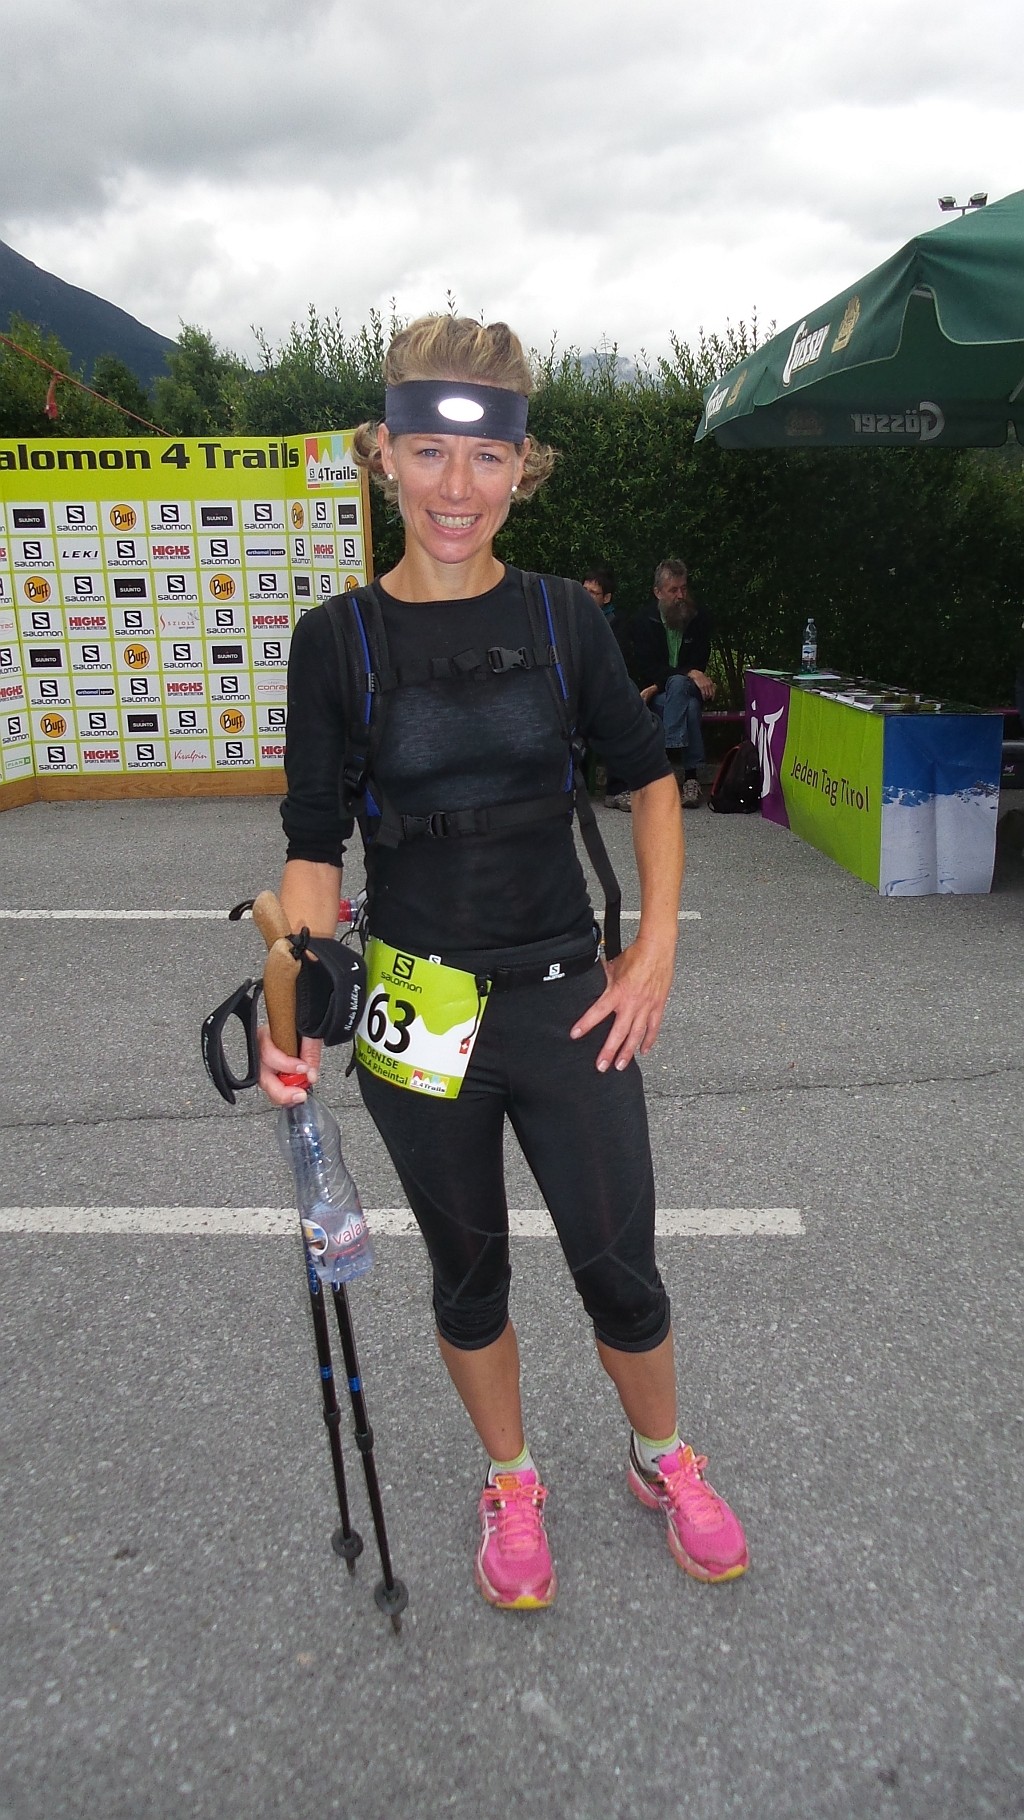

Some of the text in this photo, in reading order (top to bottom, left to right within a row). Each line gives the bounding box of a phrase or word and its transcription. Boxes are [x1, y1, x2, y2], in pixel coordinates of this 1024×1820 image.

[161, 444, 190, 469] 4
[198, 443, 299, 468] Trails
[791, 756, 869, 812] Jeden Tag Tirol
[381, 971, 422, 994] salomon
[367, 993, 416, 1053] 63
[367, 1045, 399, 1069] DENISE
[373, 1064, 408, 1085] Rheintal
